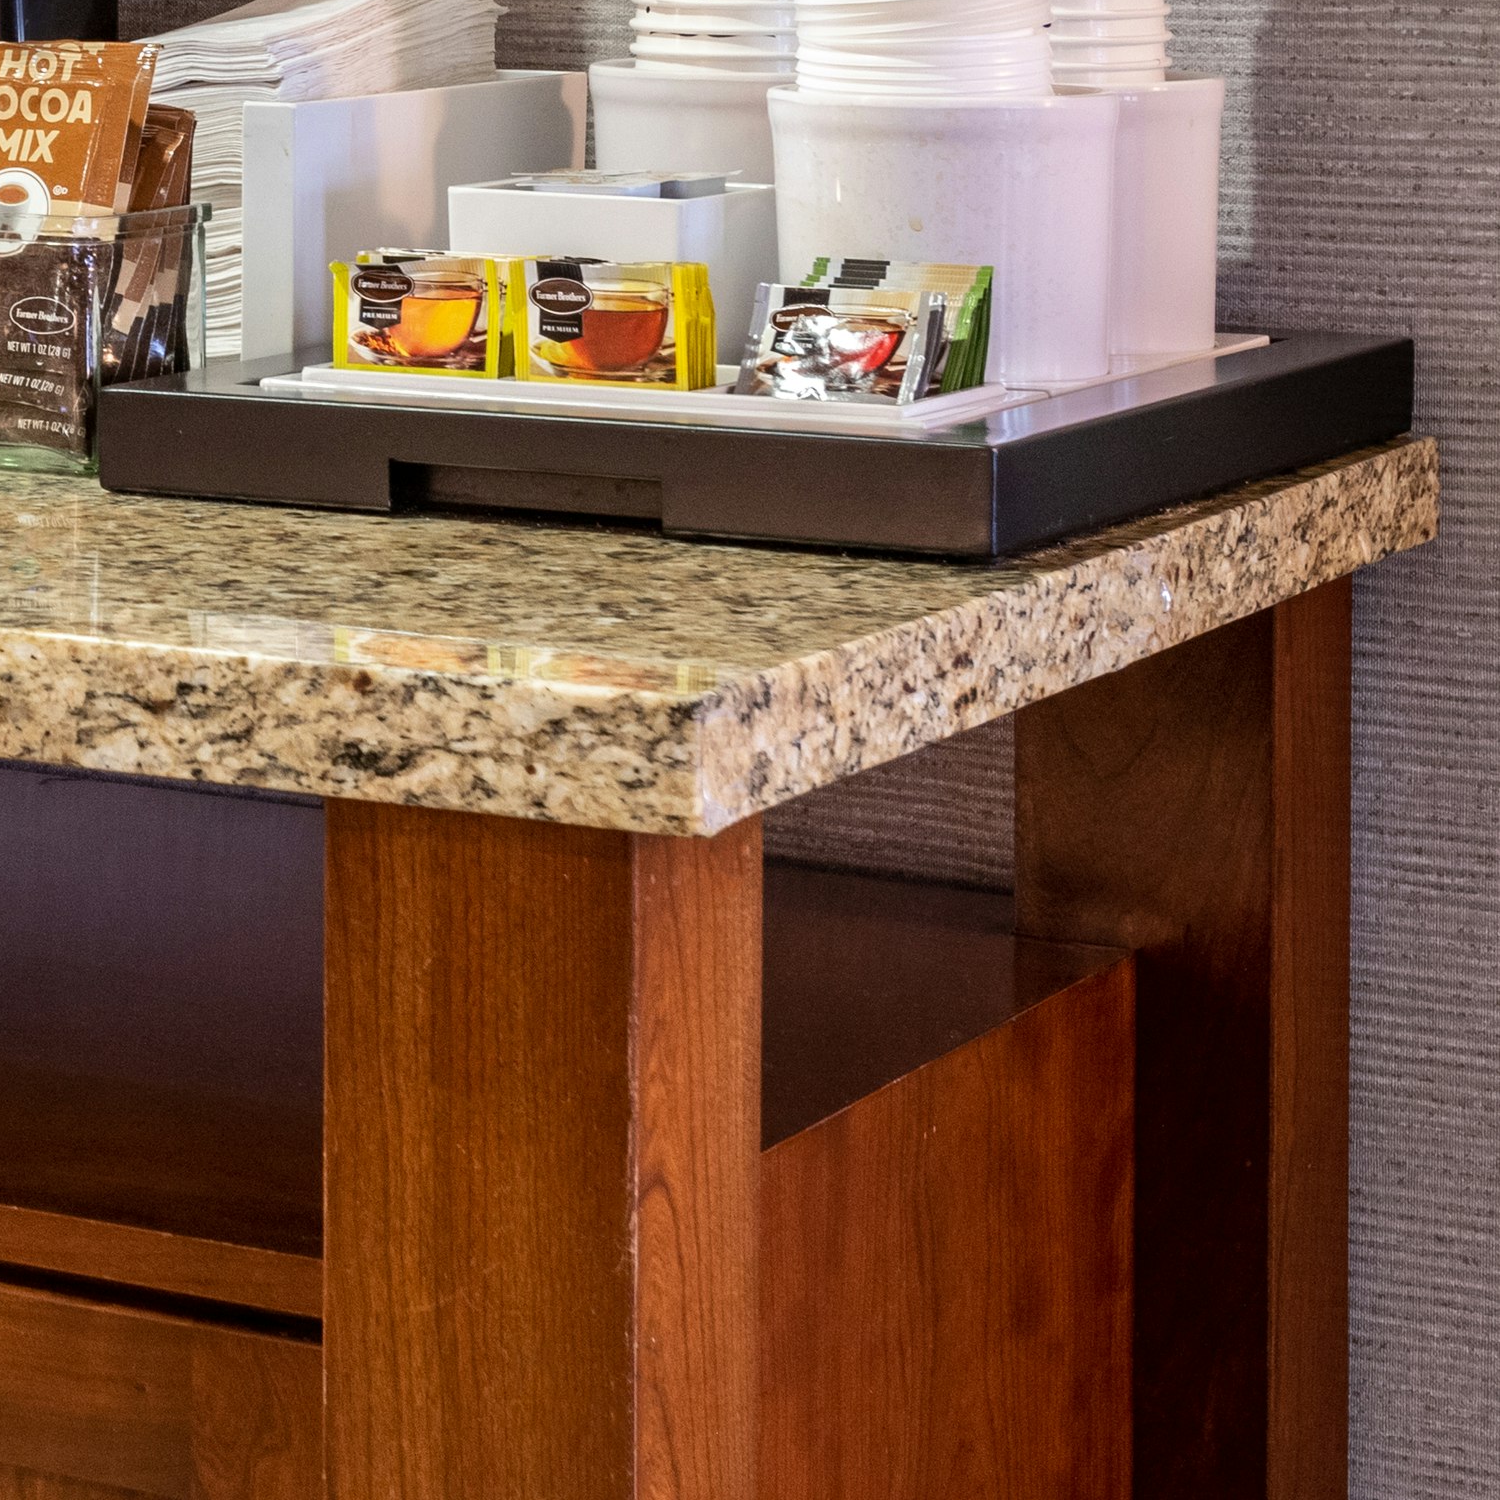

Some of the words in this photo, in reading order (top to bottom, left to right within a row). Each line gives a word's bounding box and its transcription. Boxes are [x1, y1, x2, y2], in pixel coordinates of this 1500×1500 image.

[542, 325, 579, 333] PREMIUM
[7, 341, 19, 352] NET
[20, 342, 31, 353] WT
[37, 344, 47, 355] OZ
[12, 374, 24, 386] WT
[17, 418, 32, 430] NET
[32, 419, 44, 430] WT
